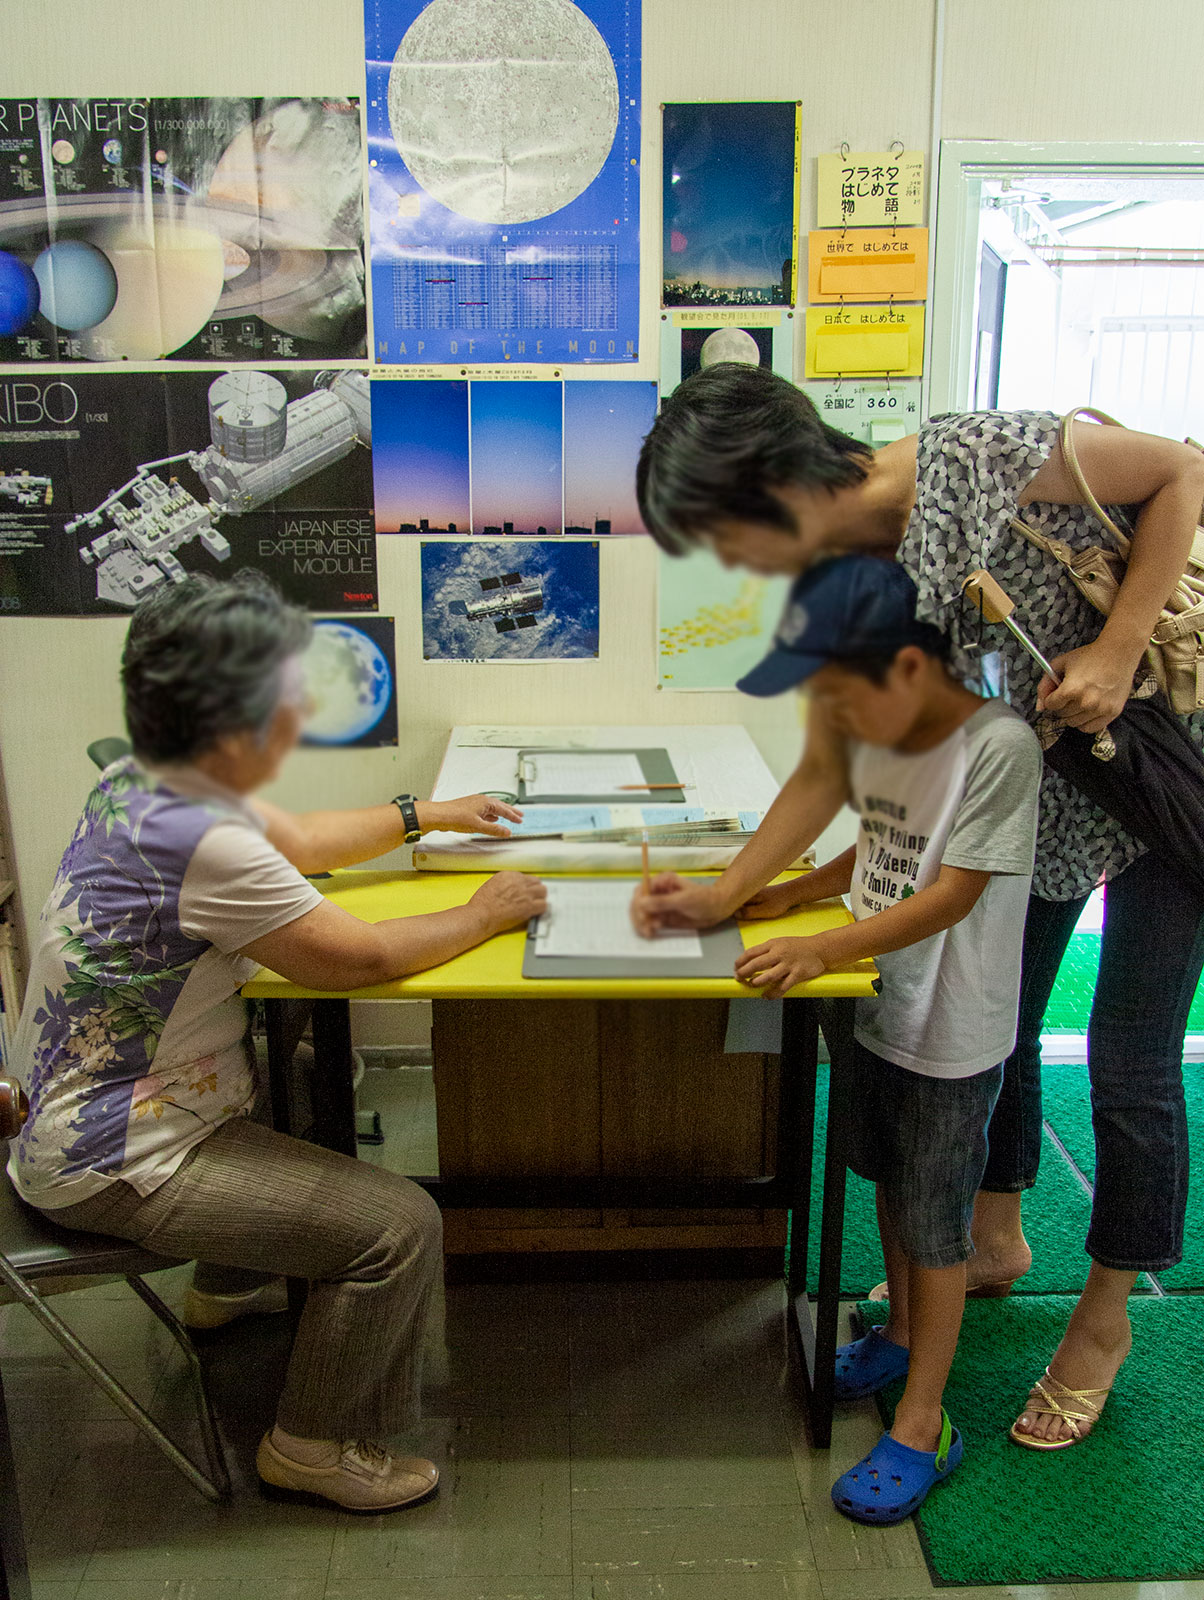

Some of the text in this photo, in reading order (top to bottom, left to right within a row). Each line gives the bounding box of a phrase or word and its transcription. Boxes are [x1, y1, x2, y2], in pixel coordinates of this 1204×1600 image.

[18, 103, 148, 132] PANETS
[841, 166, 899, 182] プラネタ
[841, 182, 899, 198] はじめて
[863, 242, 909, 252] はじめては
[860, 314, 905, 324] はじめては
[378, 339, 634, 355] MAP OF THE MOON
[824, 398, 855, 410] 全国に
[867, 397, 897, 408] 360
[277, 519, 371, 537] JAPANESE
[258, 539, 372, 557] EXPERIMENT
[293, 557, 373, 575] MODULE
[343, 591, 374, 602] Newton
[868, 871, 898, 899] Smile
